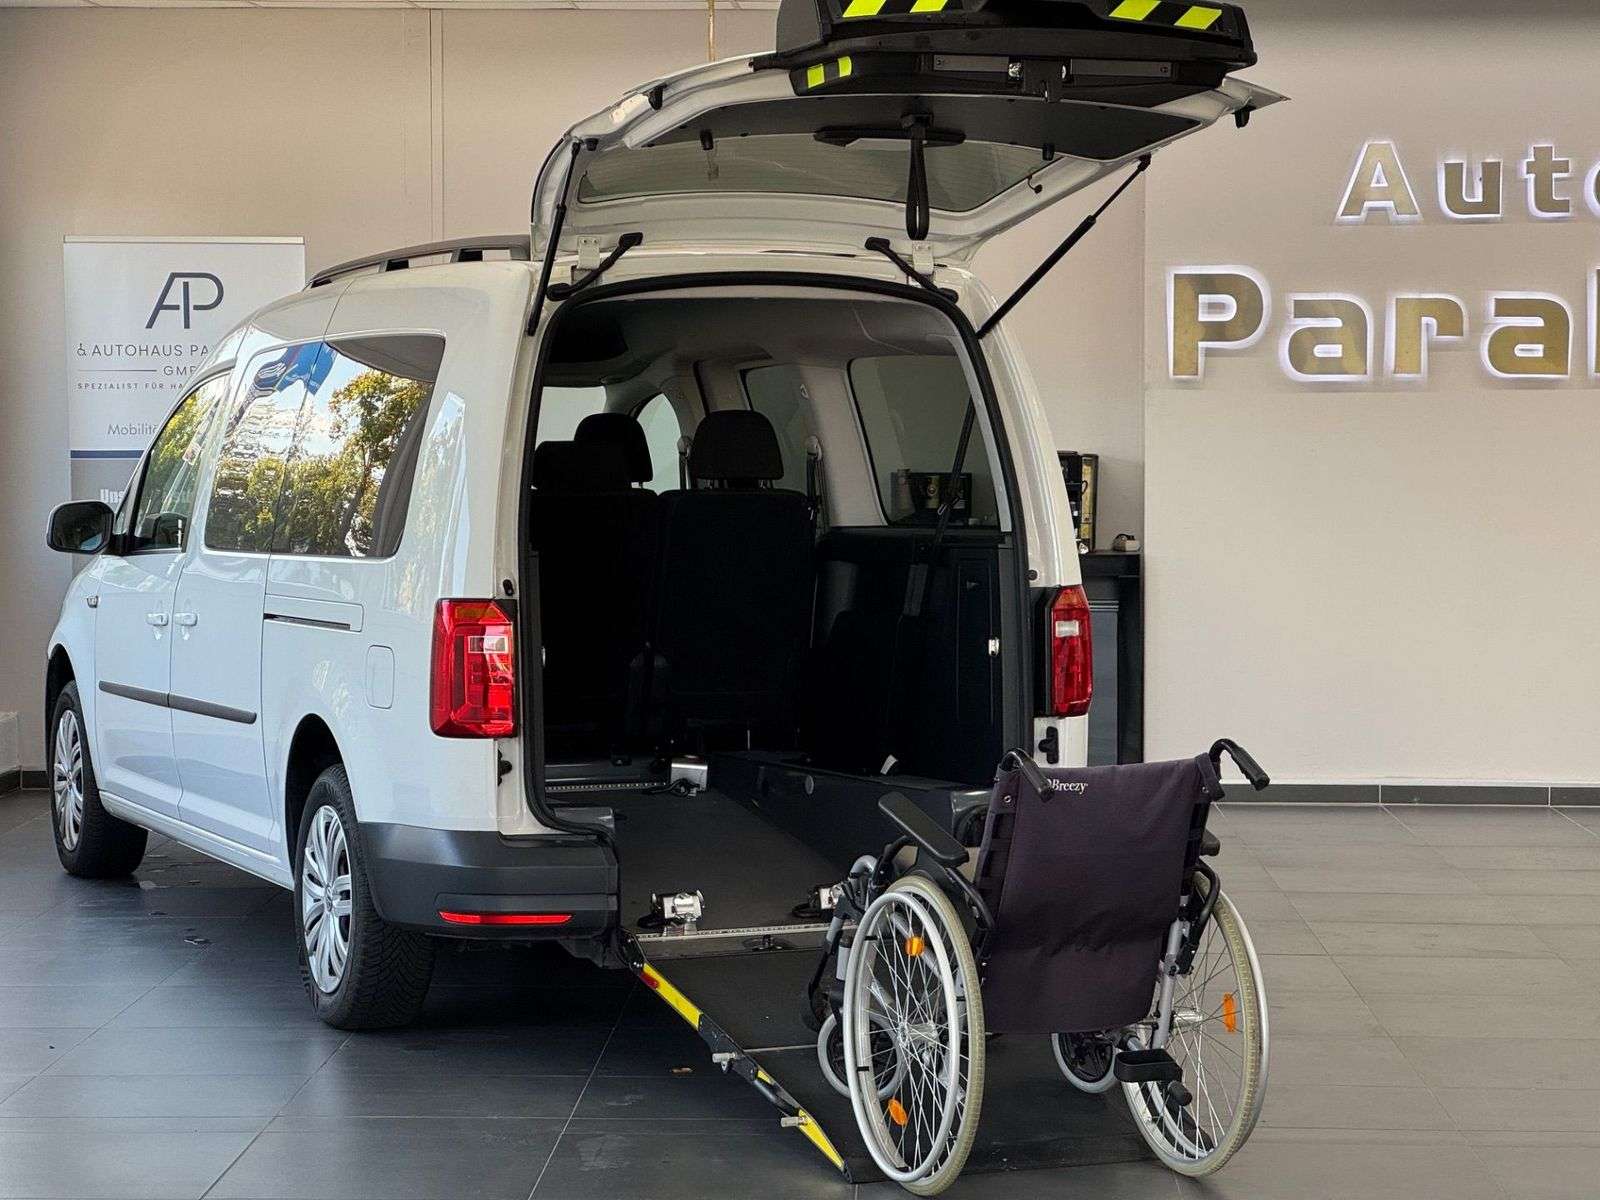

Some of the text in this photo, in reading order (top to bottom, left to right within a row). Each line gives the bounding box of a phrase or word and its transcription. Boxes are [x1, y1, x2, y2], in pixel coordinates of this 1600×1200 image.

[145, 271, 225, 330] AP
[1168, 266, 1600, 379] Para
[91, 344, 184, 357] AUTOHAUS
[77, 382, 139, 390] SPEZIALIST
[145, 380, 166, 390] FÜR
[1052, 778, 1086, 795] Breezy
